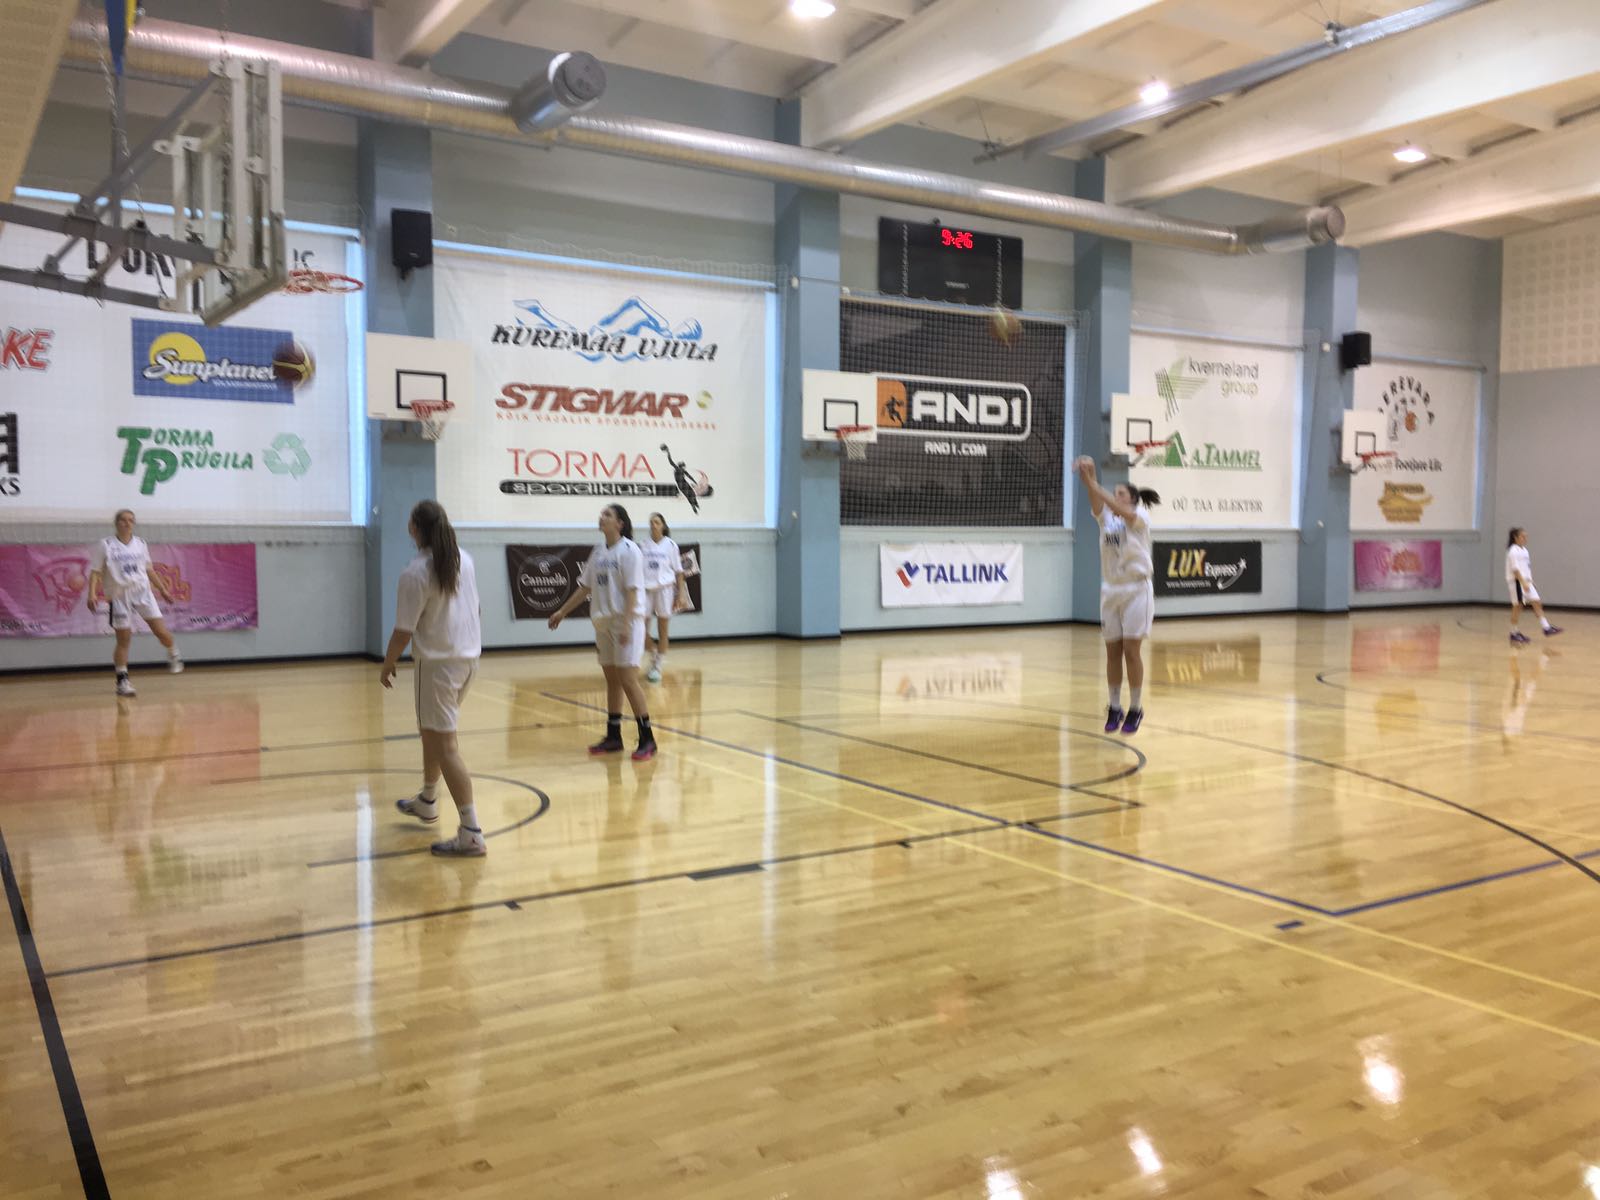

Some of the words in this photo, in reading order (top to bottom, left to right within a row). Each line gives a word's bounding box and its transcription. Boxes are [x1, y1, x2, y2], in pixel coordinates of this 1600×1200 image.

[941, 228, 973, 249] 9:26
[491, 324, 627, 354] KUREMAA
[638, 337, 719, 361] UJULA
[1188, 356, 1260, 379] kverneland
[495, 383, 690, 418] STIGMAR
[1221, 380, 1259, 398] group
[912, 390, 1023, 428] AND1
[924, 440, 987, 457] AND1.COM
[506, 447, 657, 480] TORMA
[922, 562, 1009, 585] TALLINK
[1167, 549, 1206, 578] LUX
